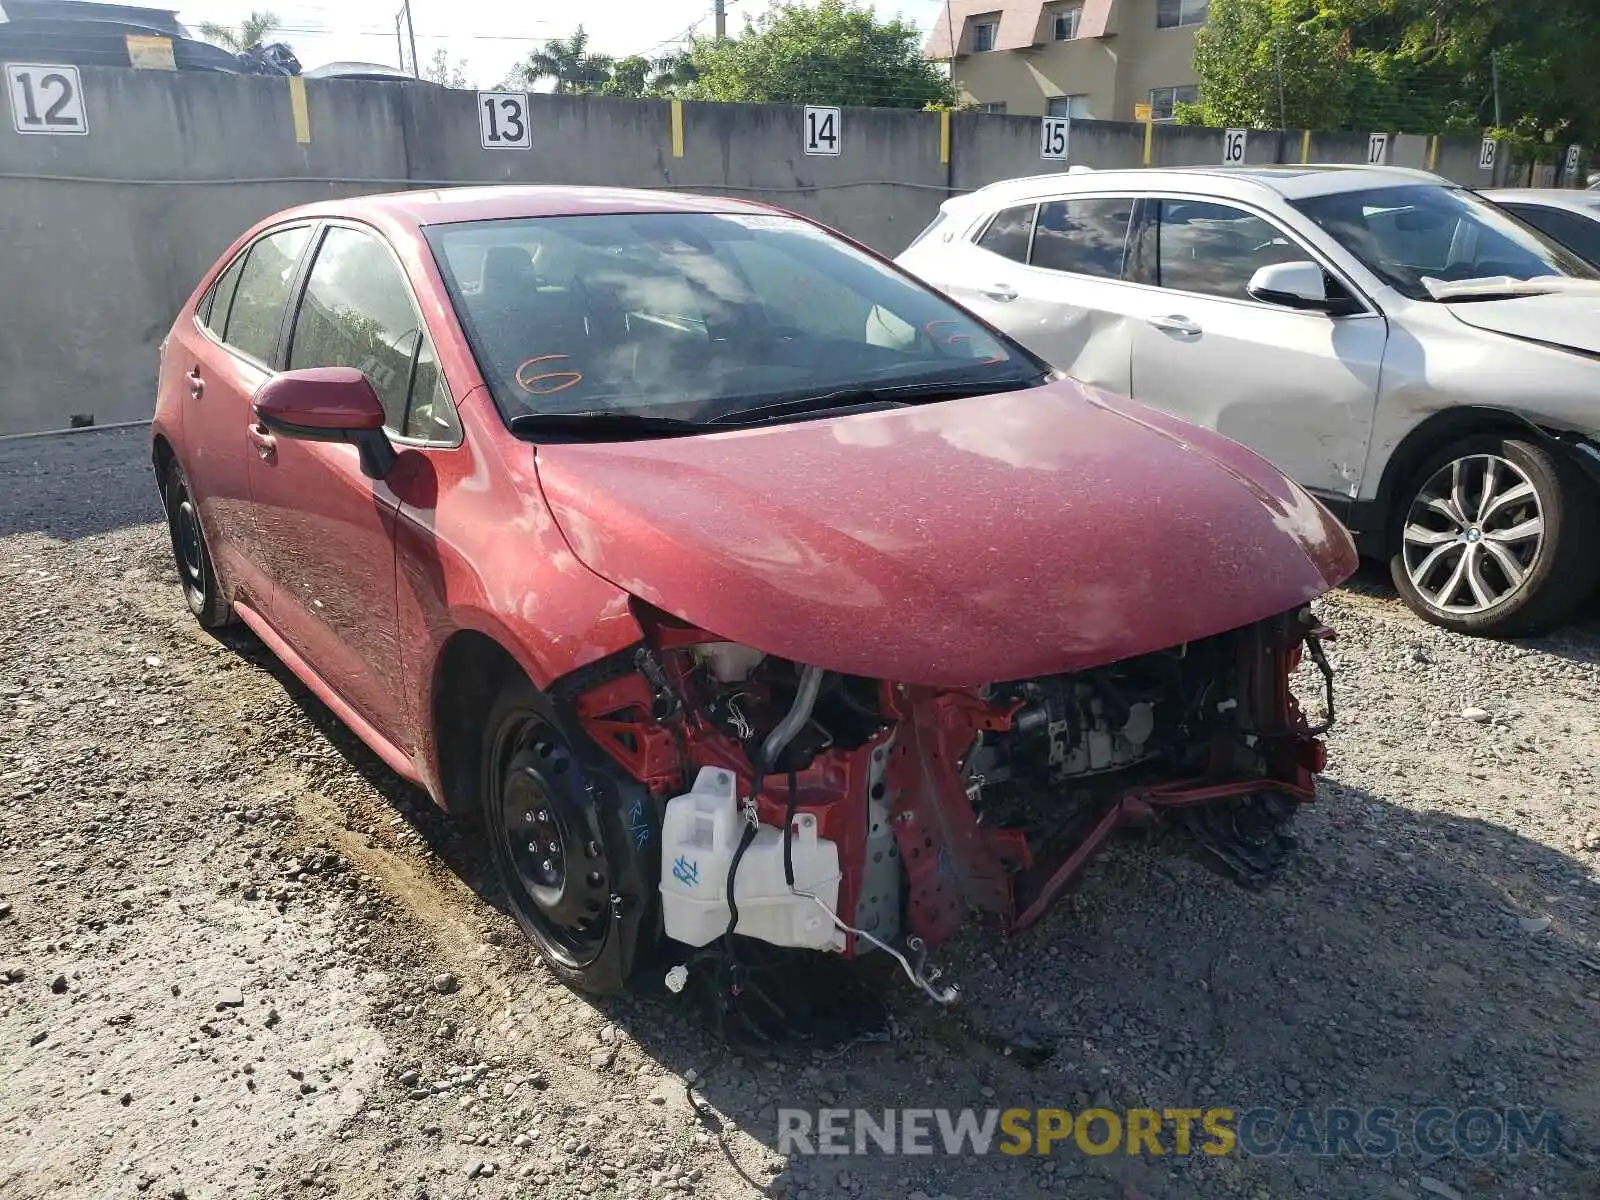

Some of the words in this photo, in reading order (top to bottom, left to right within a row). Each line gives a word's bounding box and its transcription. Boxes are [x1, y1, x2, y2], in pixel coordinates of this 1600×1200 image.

[16, 72, 80, 126] 12
[484, 98, 524, 142] 13
[807, 112, 838, 149] 14
[1044, 122, 1065, 154] 15
[1224, 134, 1243, 161] 16
[1369, 137, 1385, 162] 17
[1480, 142, 1494, 165] 18
[1566, 148, 1578, 170] 19
[515, 354, 583, 395] 6
